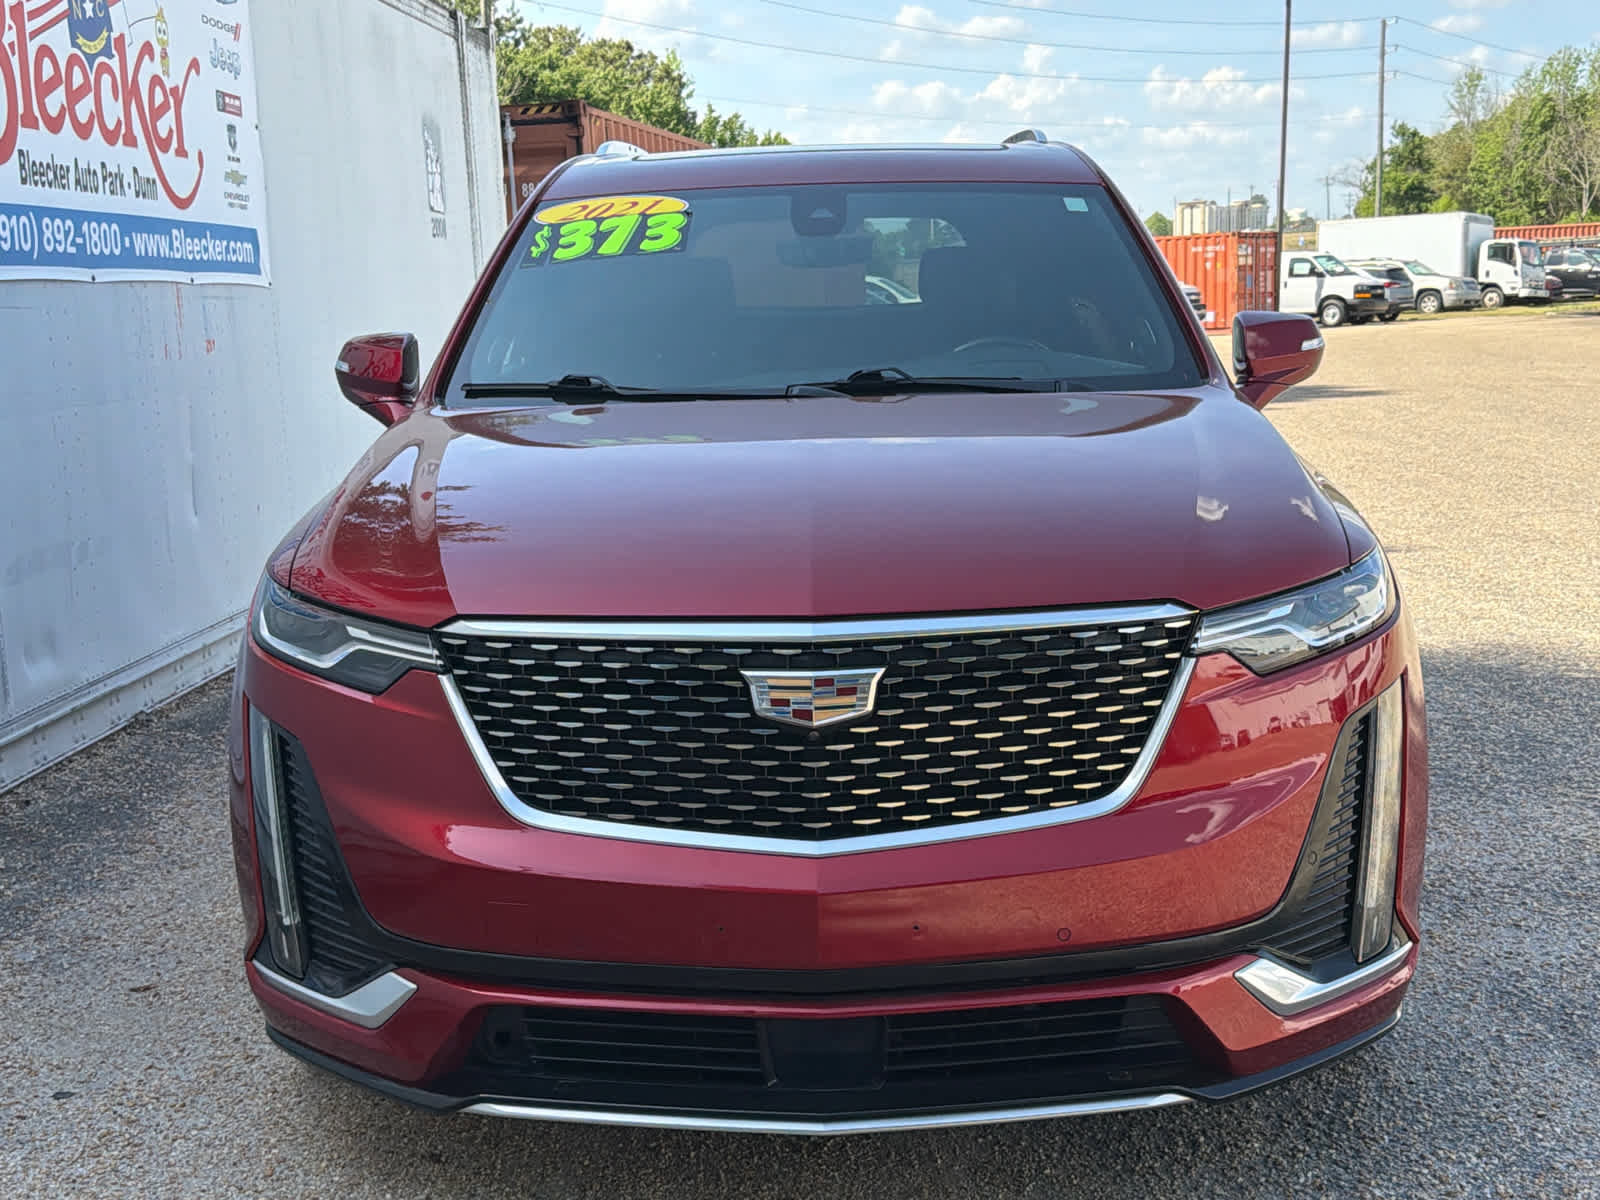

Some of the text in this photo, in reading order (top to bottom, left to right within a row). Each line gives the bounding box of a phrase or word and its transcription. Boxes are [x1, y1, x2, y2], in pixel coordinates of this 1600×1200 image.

[201, 14, 236, 34] DODGE
[17, 148, 159, 200] Bleecker Auto Park Dunn
[559, 200, 664, 221] 2021
[42, 216, 121, 256] 892-1800
[132, 228, 255, 264] www.Bleecker.com
